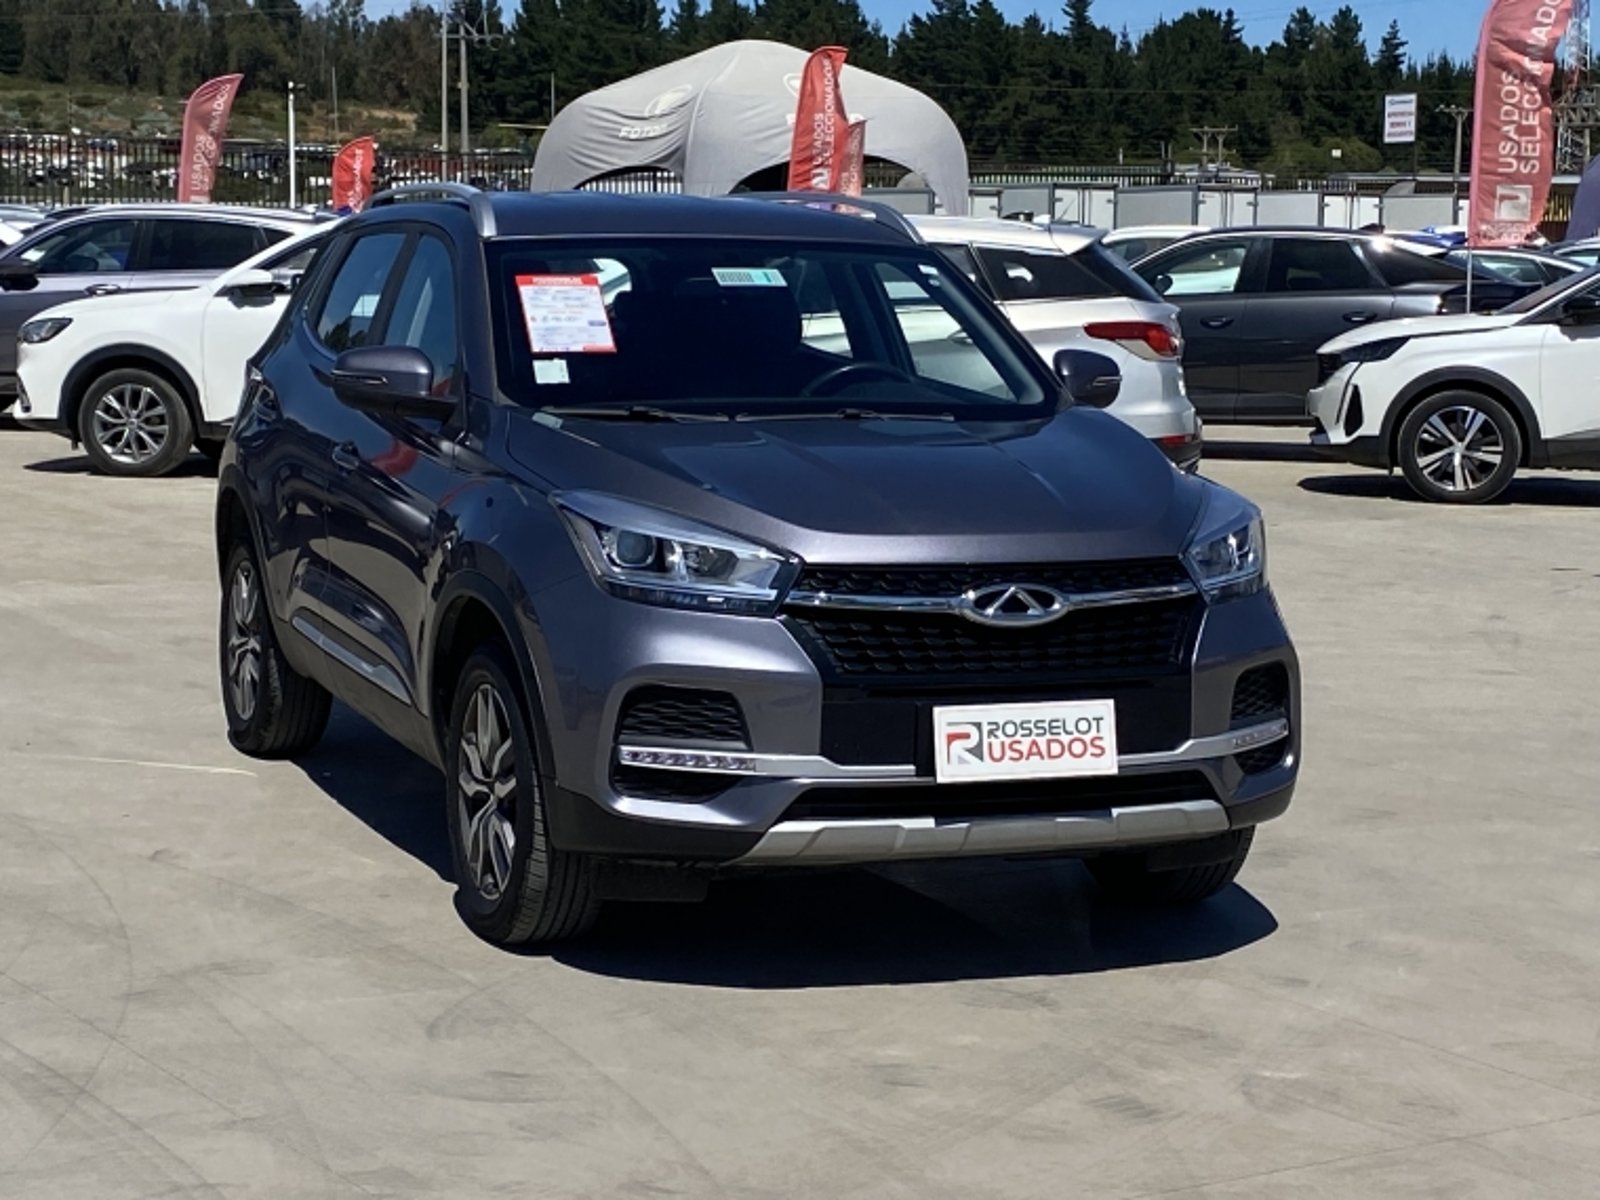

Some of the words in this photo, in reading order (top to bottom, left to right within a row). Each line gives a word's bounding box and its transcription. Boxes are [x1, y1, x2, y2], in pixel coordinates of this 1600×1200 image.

[1497, 69, 1521, 174] USADOS
[191, 134, 206, 191] USADOS
[986, 716, 1104, 739] ROSSELOT
[988, 736, 1106, 762] USADOS
